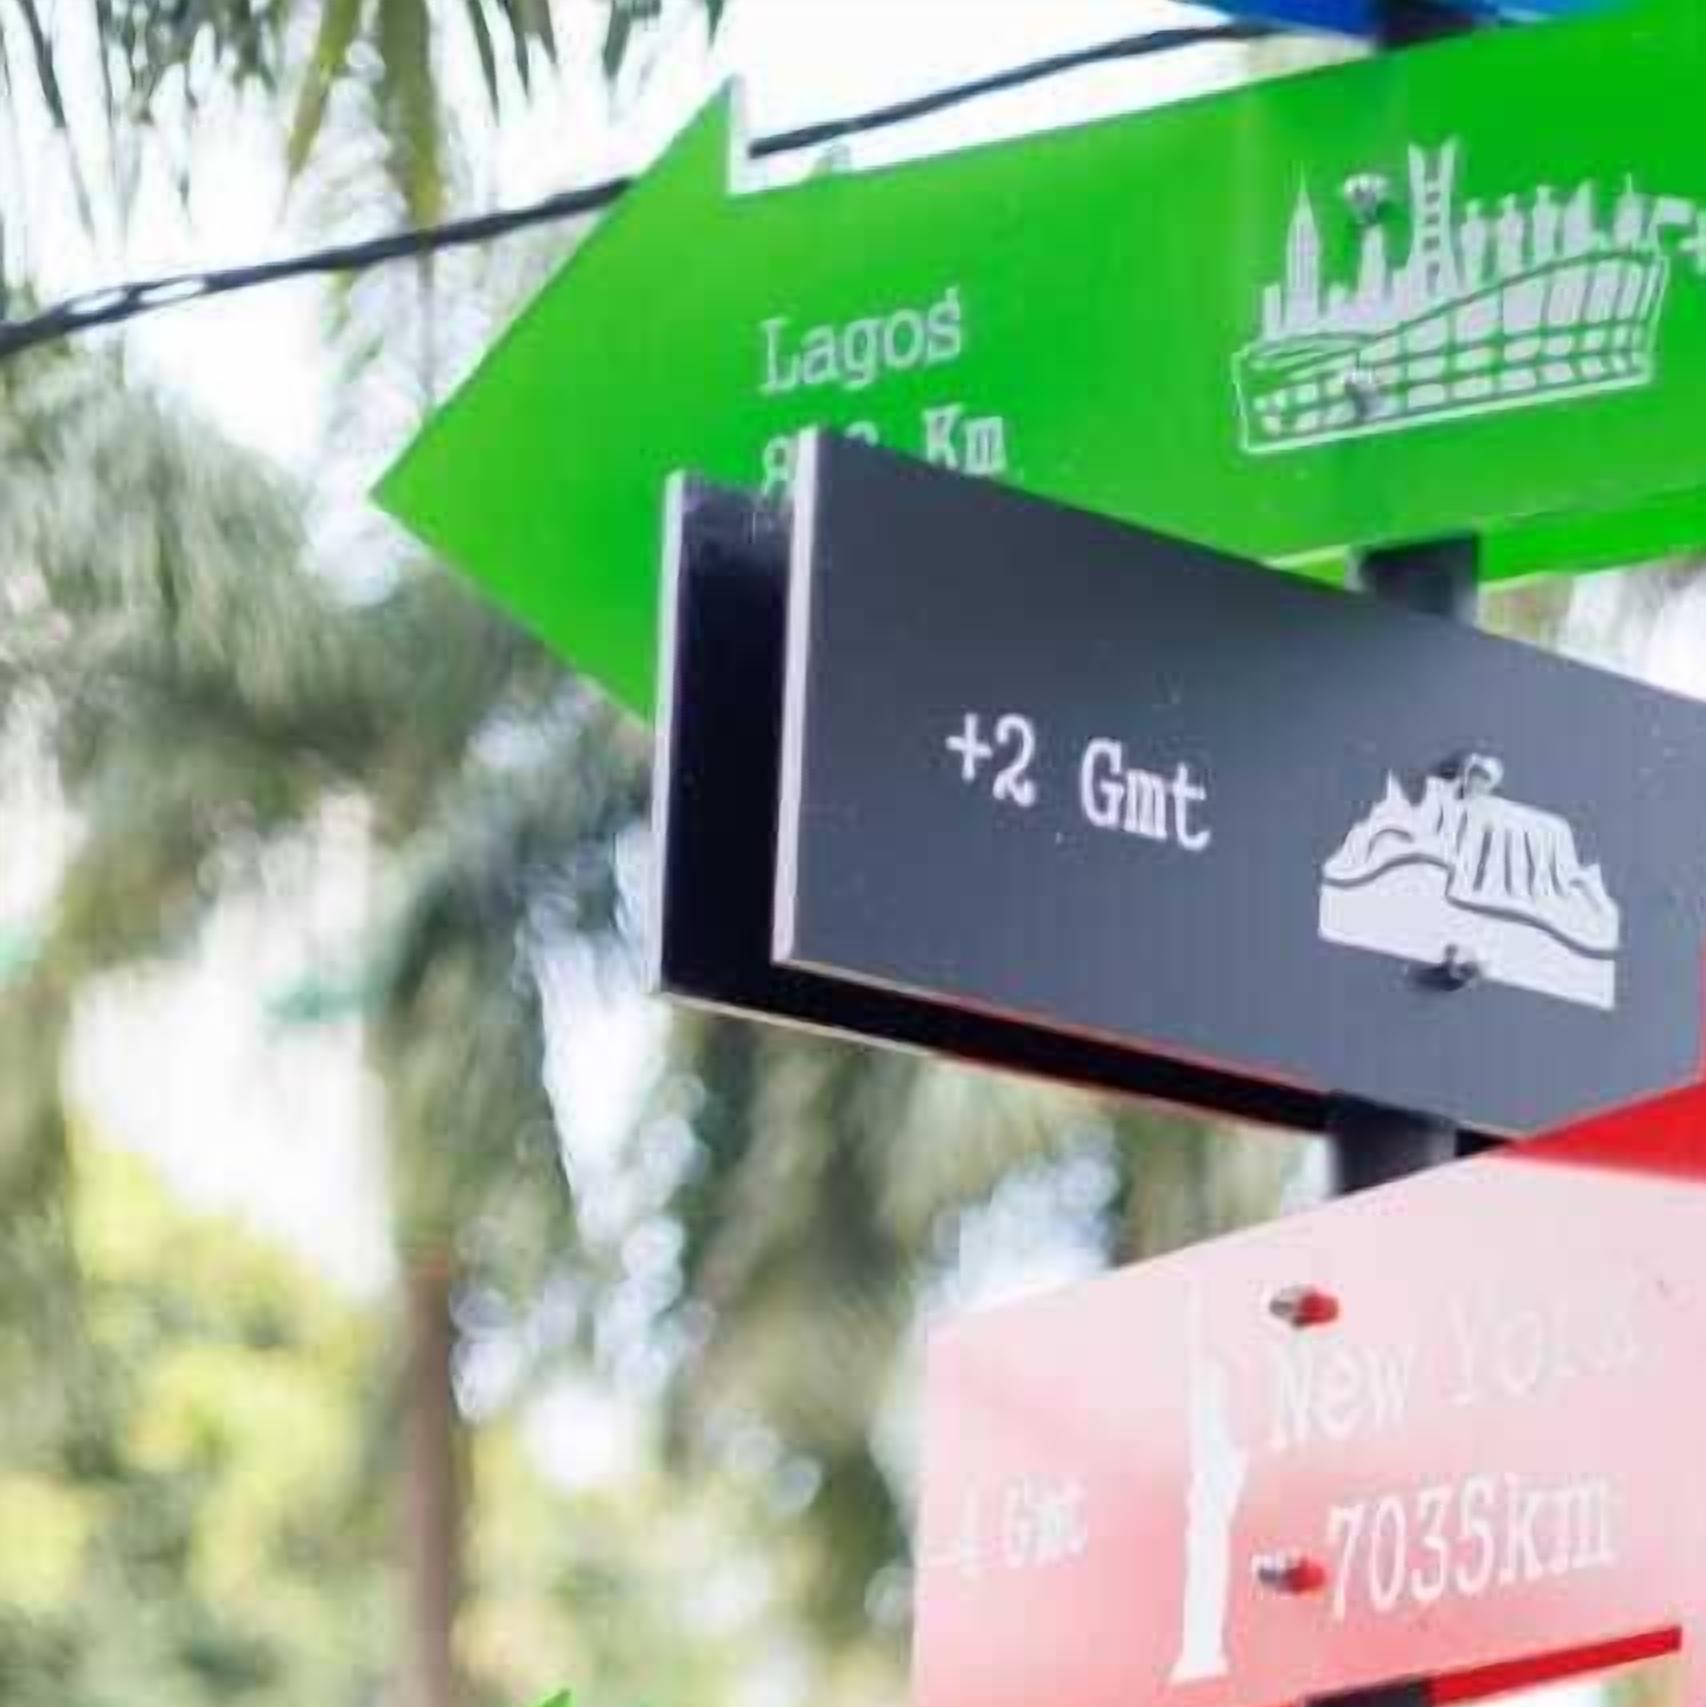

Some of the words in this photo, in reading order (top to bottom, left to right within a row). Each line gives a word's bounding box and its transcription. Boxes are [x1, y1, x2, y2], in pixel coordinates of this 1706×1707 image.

[759, 296, 961, 396] Lagos
[944, 711, 1036, 808] +2
[1080, 737, 1212, 852] Gmt
[1265, 1340, 1415, 1453] New
[1442, 1285, 1648, 1406] Yo
